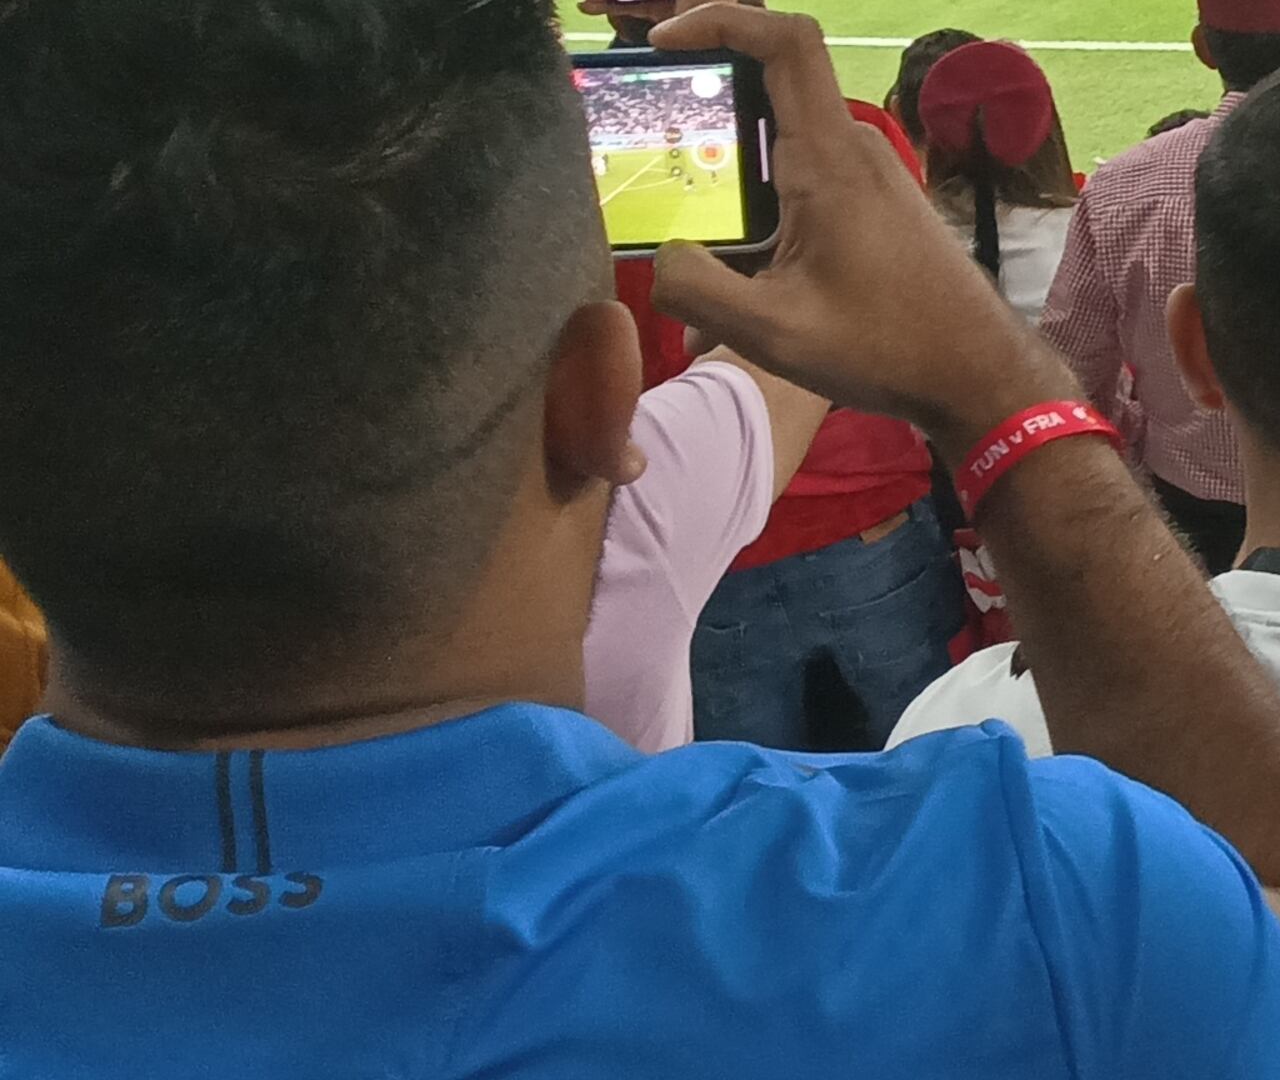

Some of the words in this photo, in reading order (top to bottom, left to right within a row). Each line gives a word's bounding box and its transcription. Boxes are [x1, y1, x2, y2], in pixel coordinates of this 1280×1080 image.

[969, 439, 1010, 478] TUN
[1022, 411, 1066, 435] FRA
[101, 871, 323, 929] BOSS
